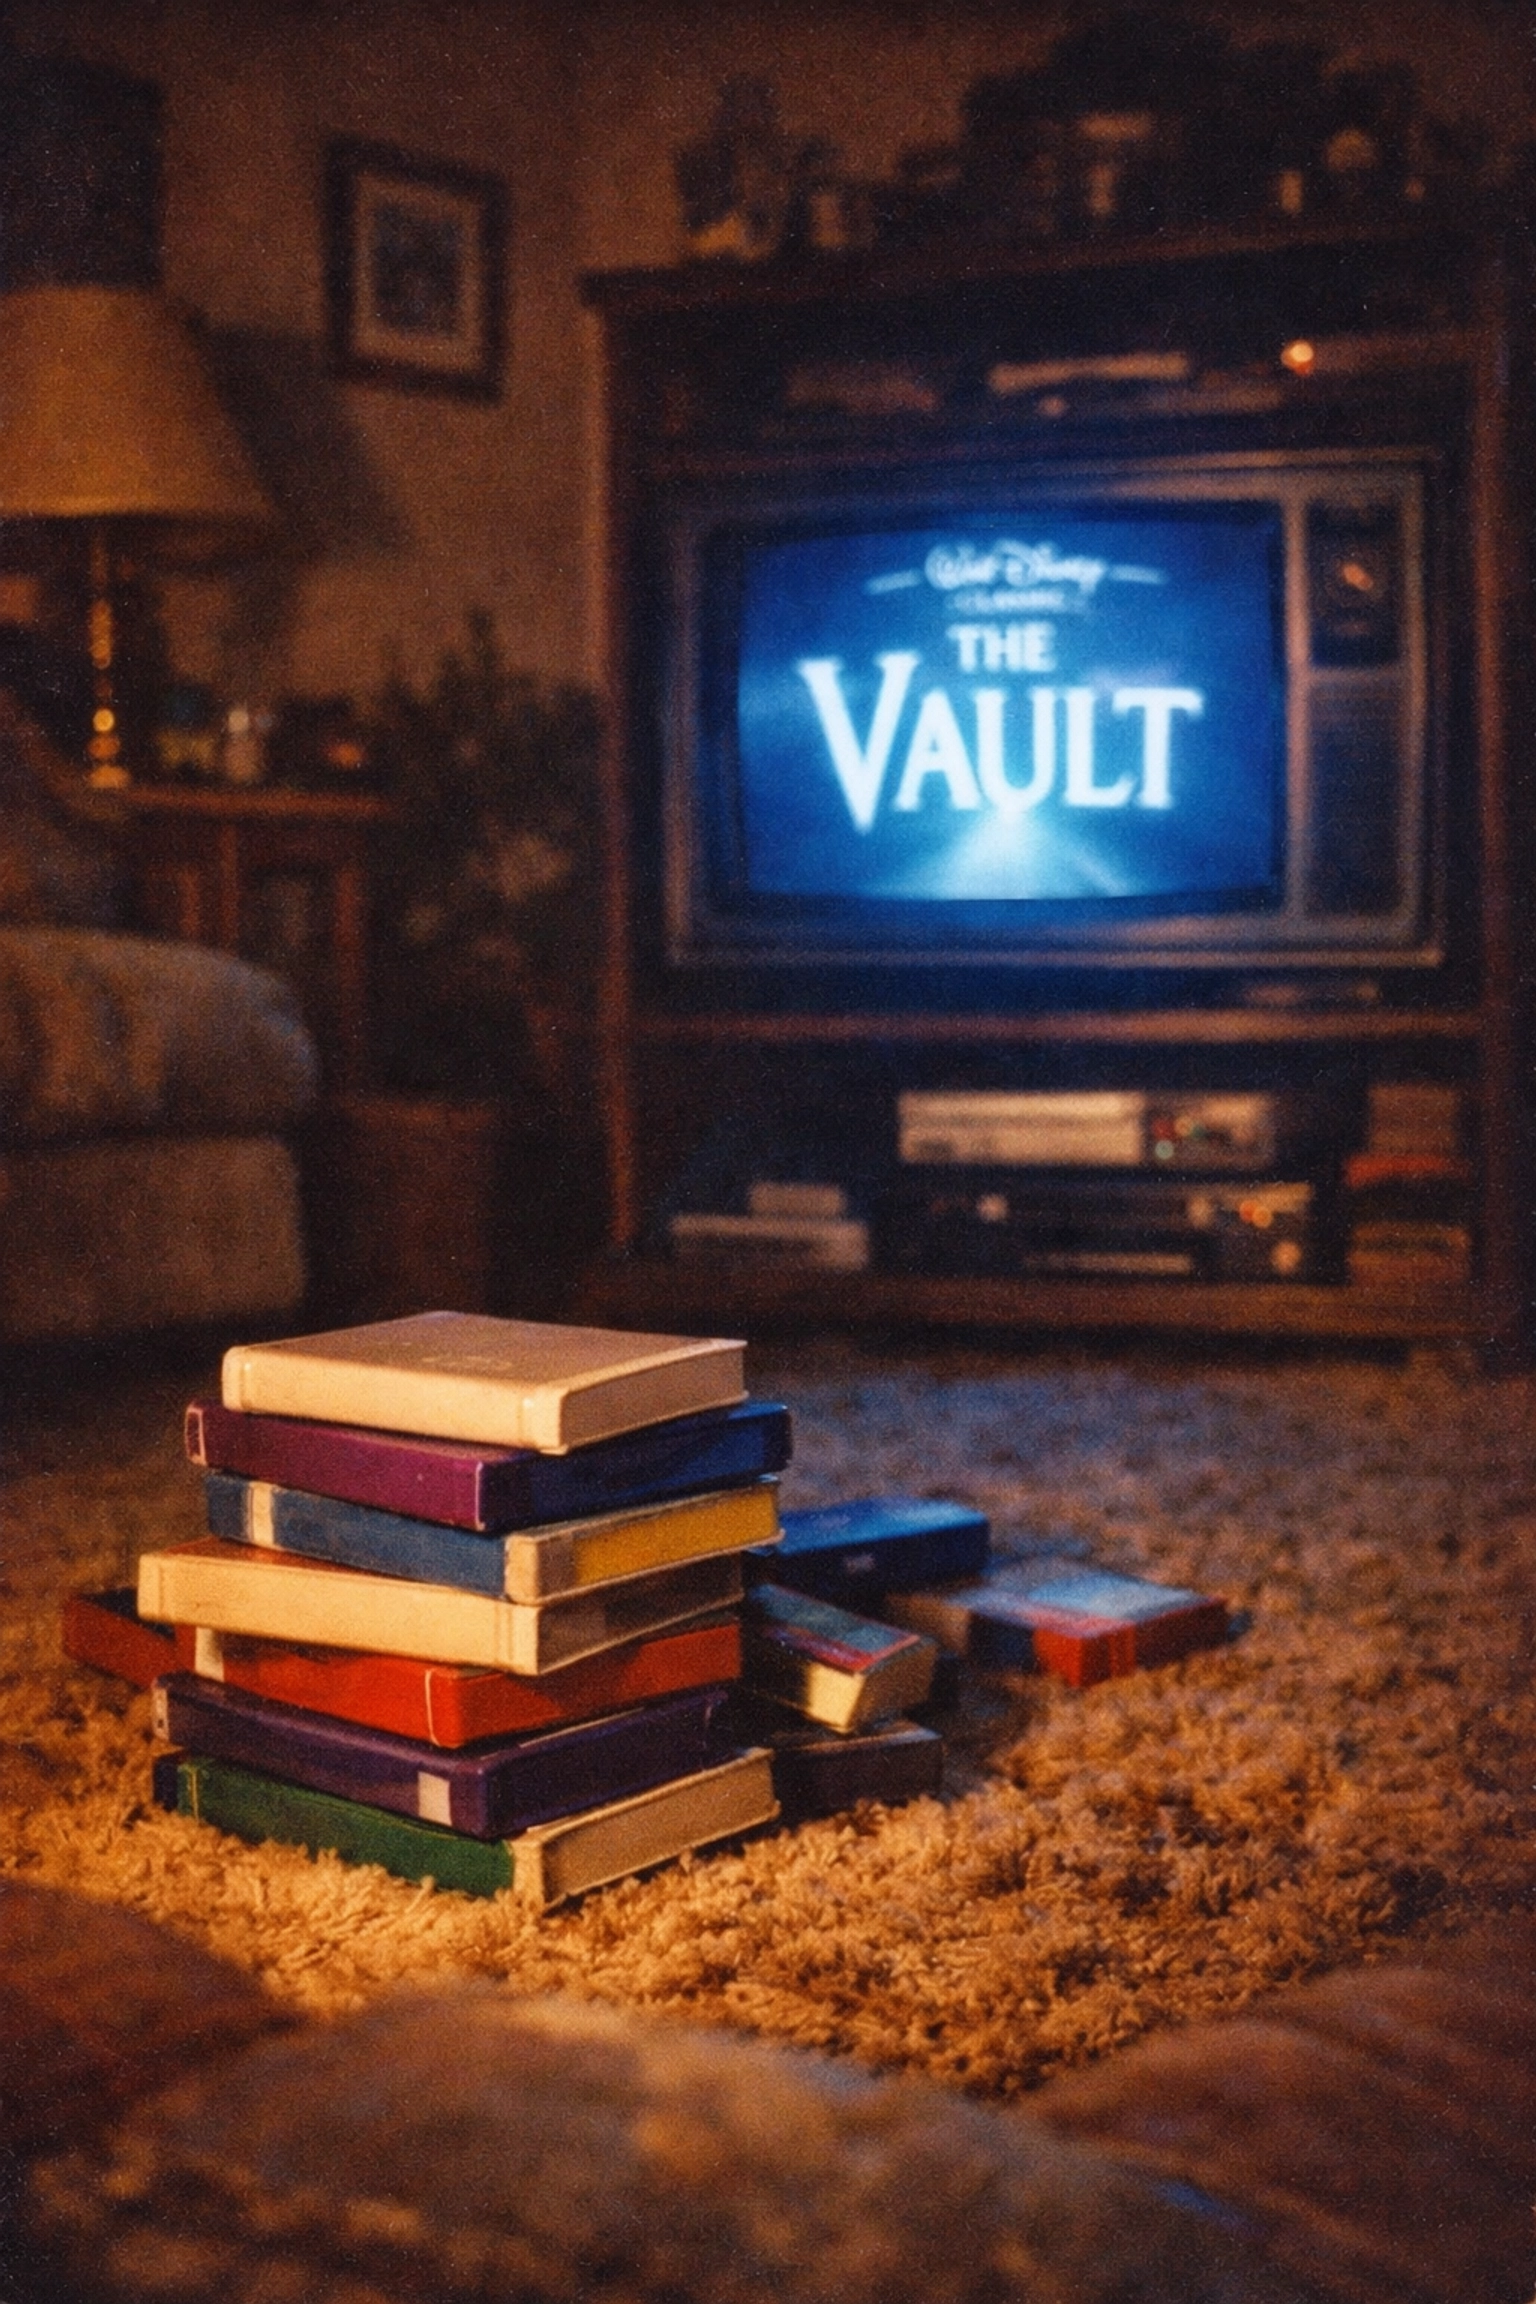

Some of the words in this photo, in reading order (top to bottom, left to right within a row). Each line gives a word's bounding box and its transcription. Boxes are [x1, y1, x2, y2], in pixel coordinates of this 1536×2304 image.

[994, 539, 1106, 597] Disney
[947, 620, 1057, 673] THE
[797, 649, 1205, 833] VAULT
